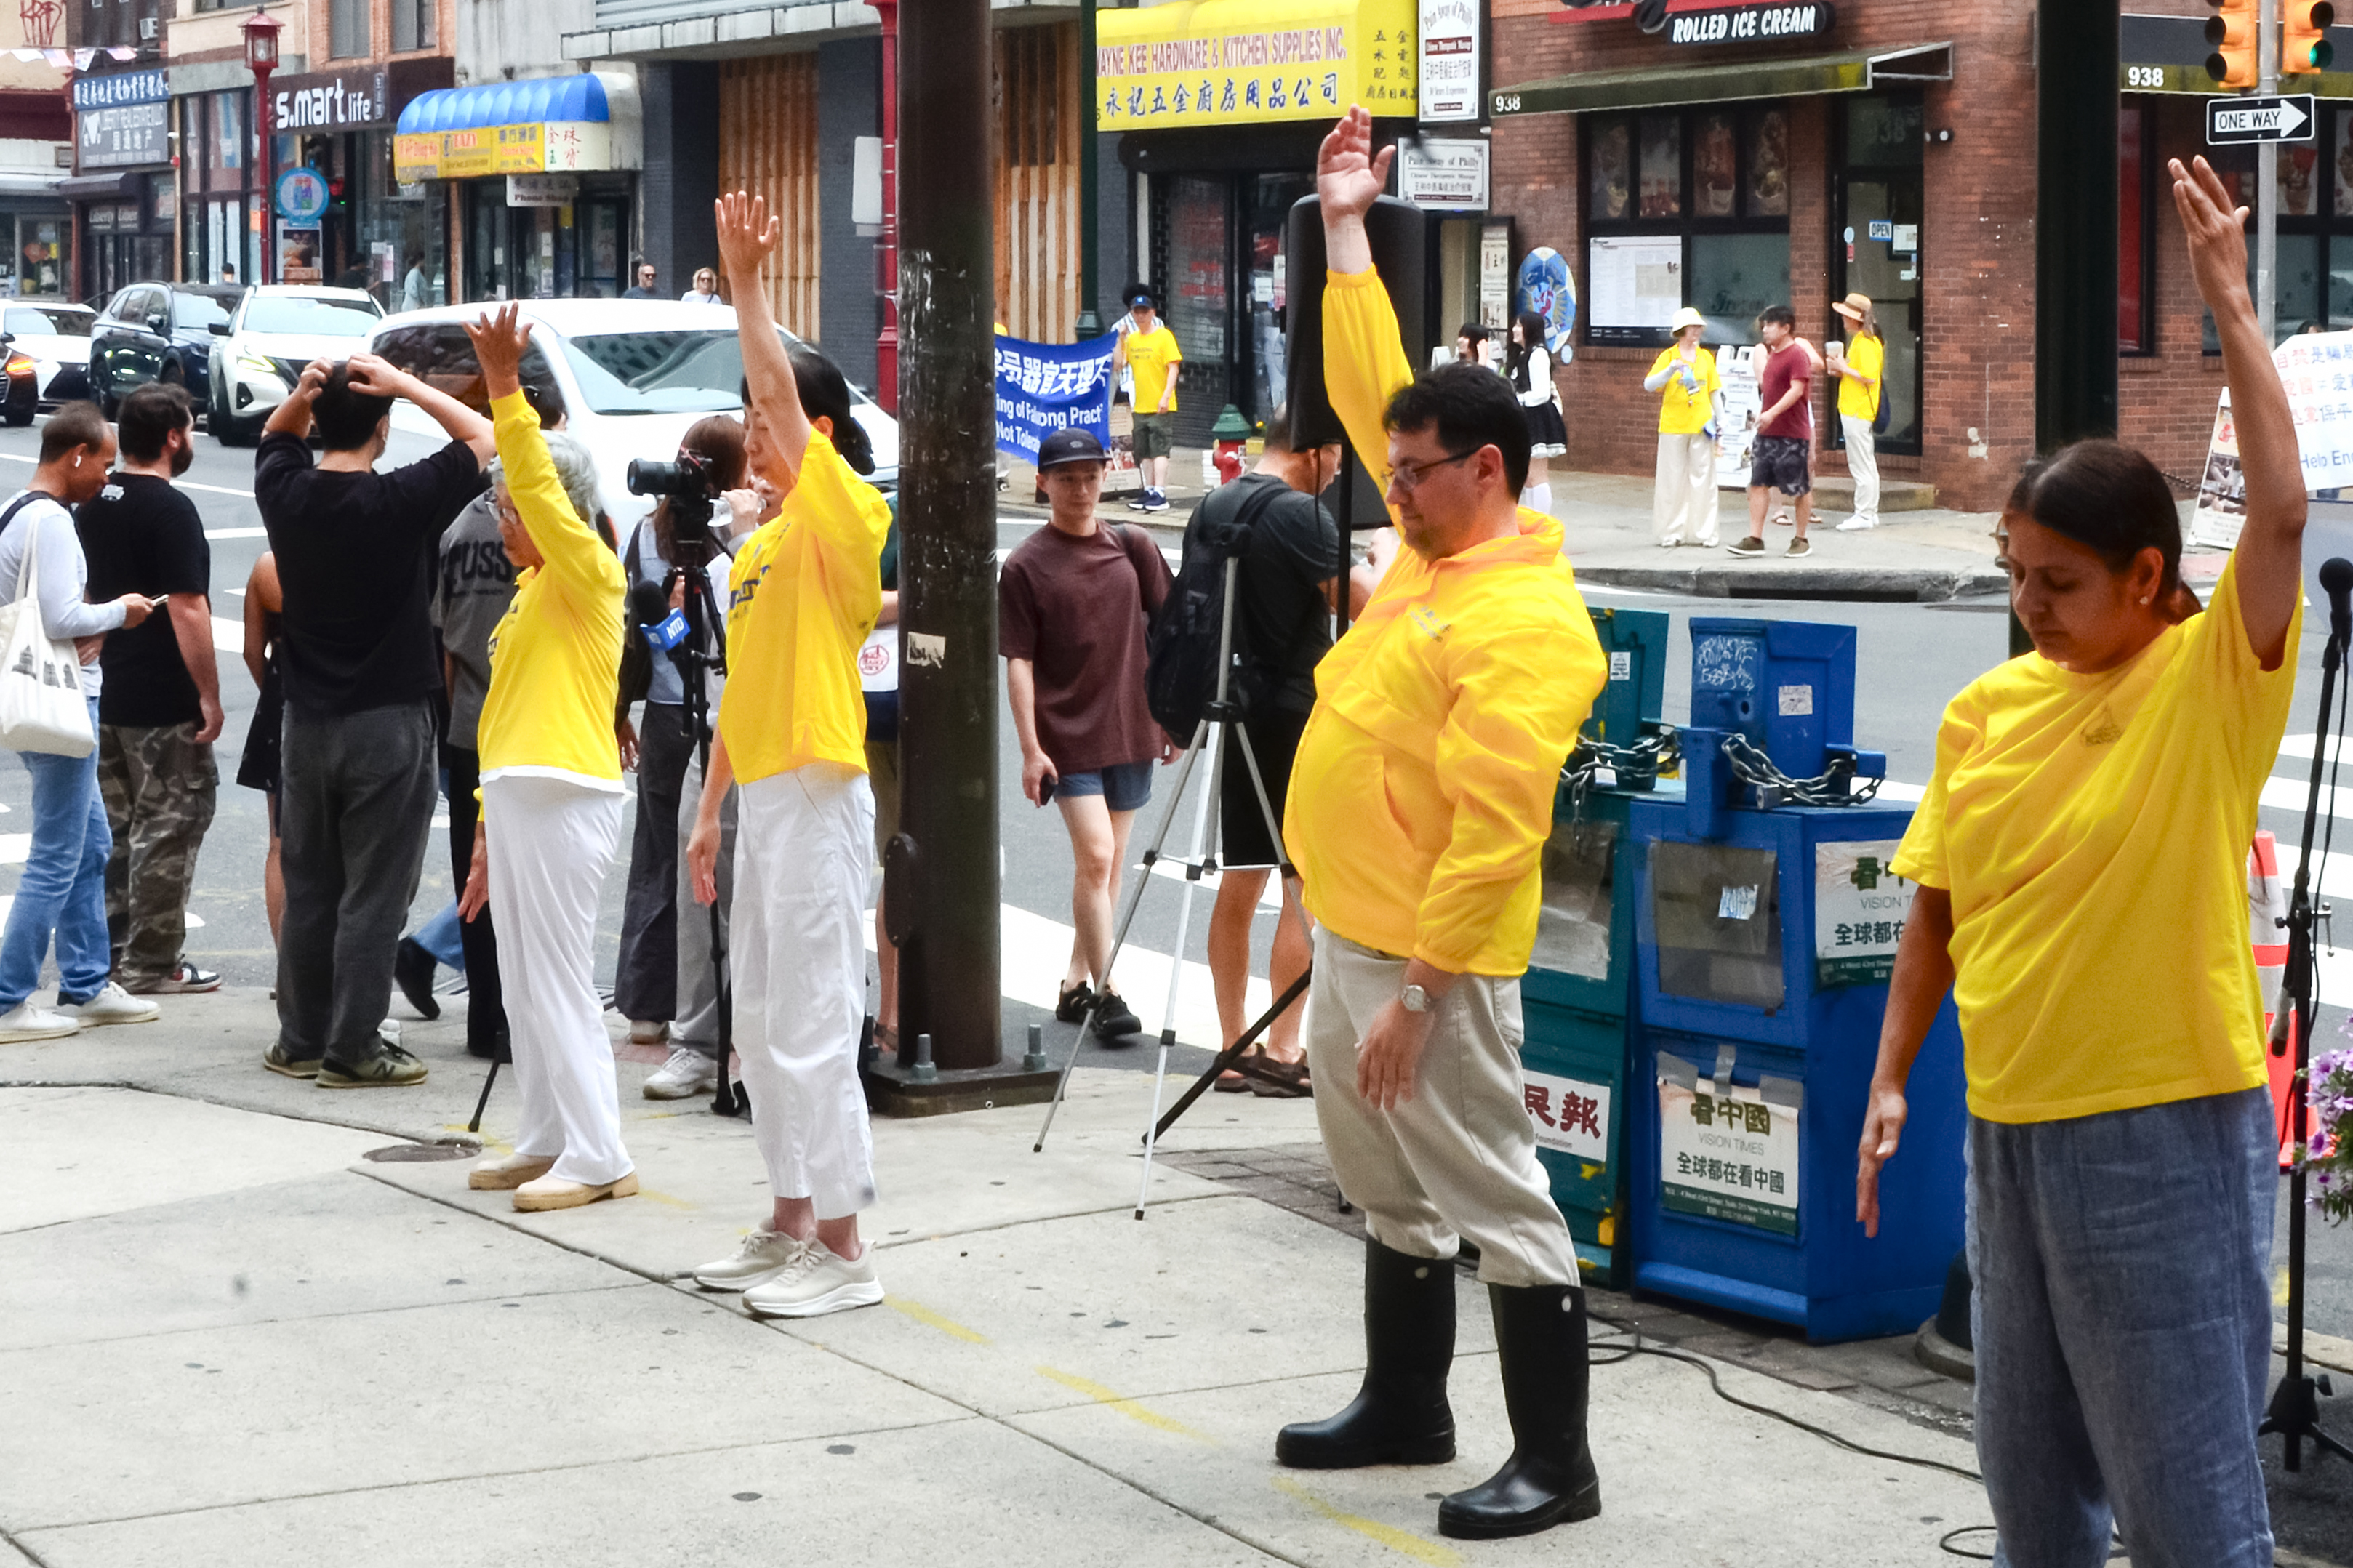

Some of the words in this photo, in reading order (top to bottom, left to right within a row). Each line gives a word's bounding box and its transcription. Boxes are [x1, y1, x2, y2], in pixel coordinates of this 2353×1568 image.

[1672, 14, 1728, 44] ROLLED
[1731, 10, 1757, 39] ICE
[1760, 5, 1816, 36] CREAM
[1128, 44, 1147, 75] KEE
[1151, 38, 1208, 73] HARDWARE
[1211, 37, 1219, 69] &
[1222, 33, 1269, 68] KITCHEN
[1272, 28, 1323, 65] SUPPLIES
[2127, 65, 2165, 88] 938
[348, 91, 372, 122] life
[1495, 94, 1522, 113] 938
[2218, 112, 2247, 129] ONE
[2251, 108, 2282, 128] WAY
[1871, 223, 1891, 238] OPEN
[1016, 401, 1025, 419] of
[995, 420, 1014, 443] Not
[1860, 896, 1902, 910] VISION
[1690, 1092, 1771, 1137] 看中國
[1698, 1132, 1731, 1149] VISION
[1733, 1138, 1765, 1156] TIMES
[1677, 1151, 1784, 1195] 全球都在看中國
